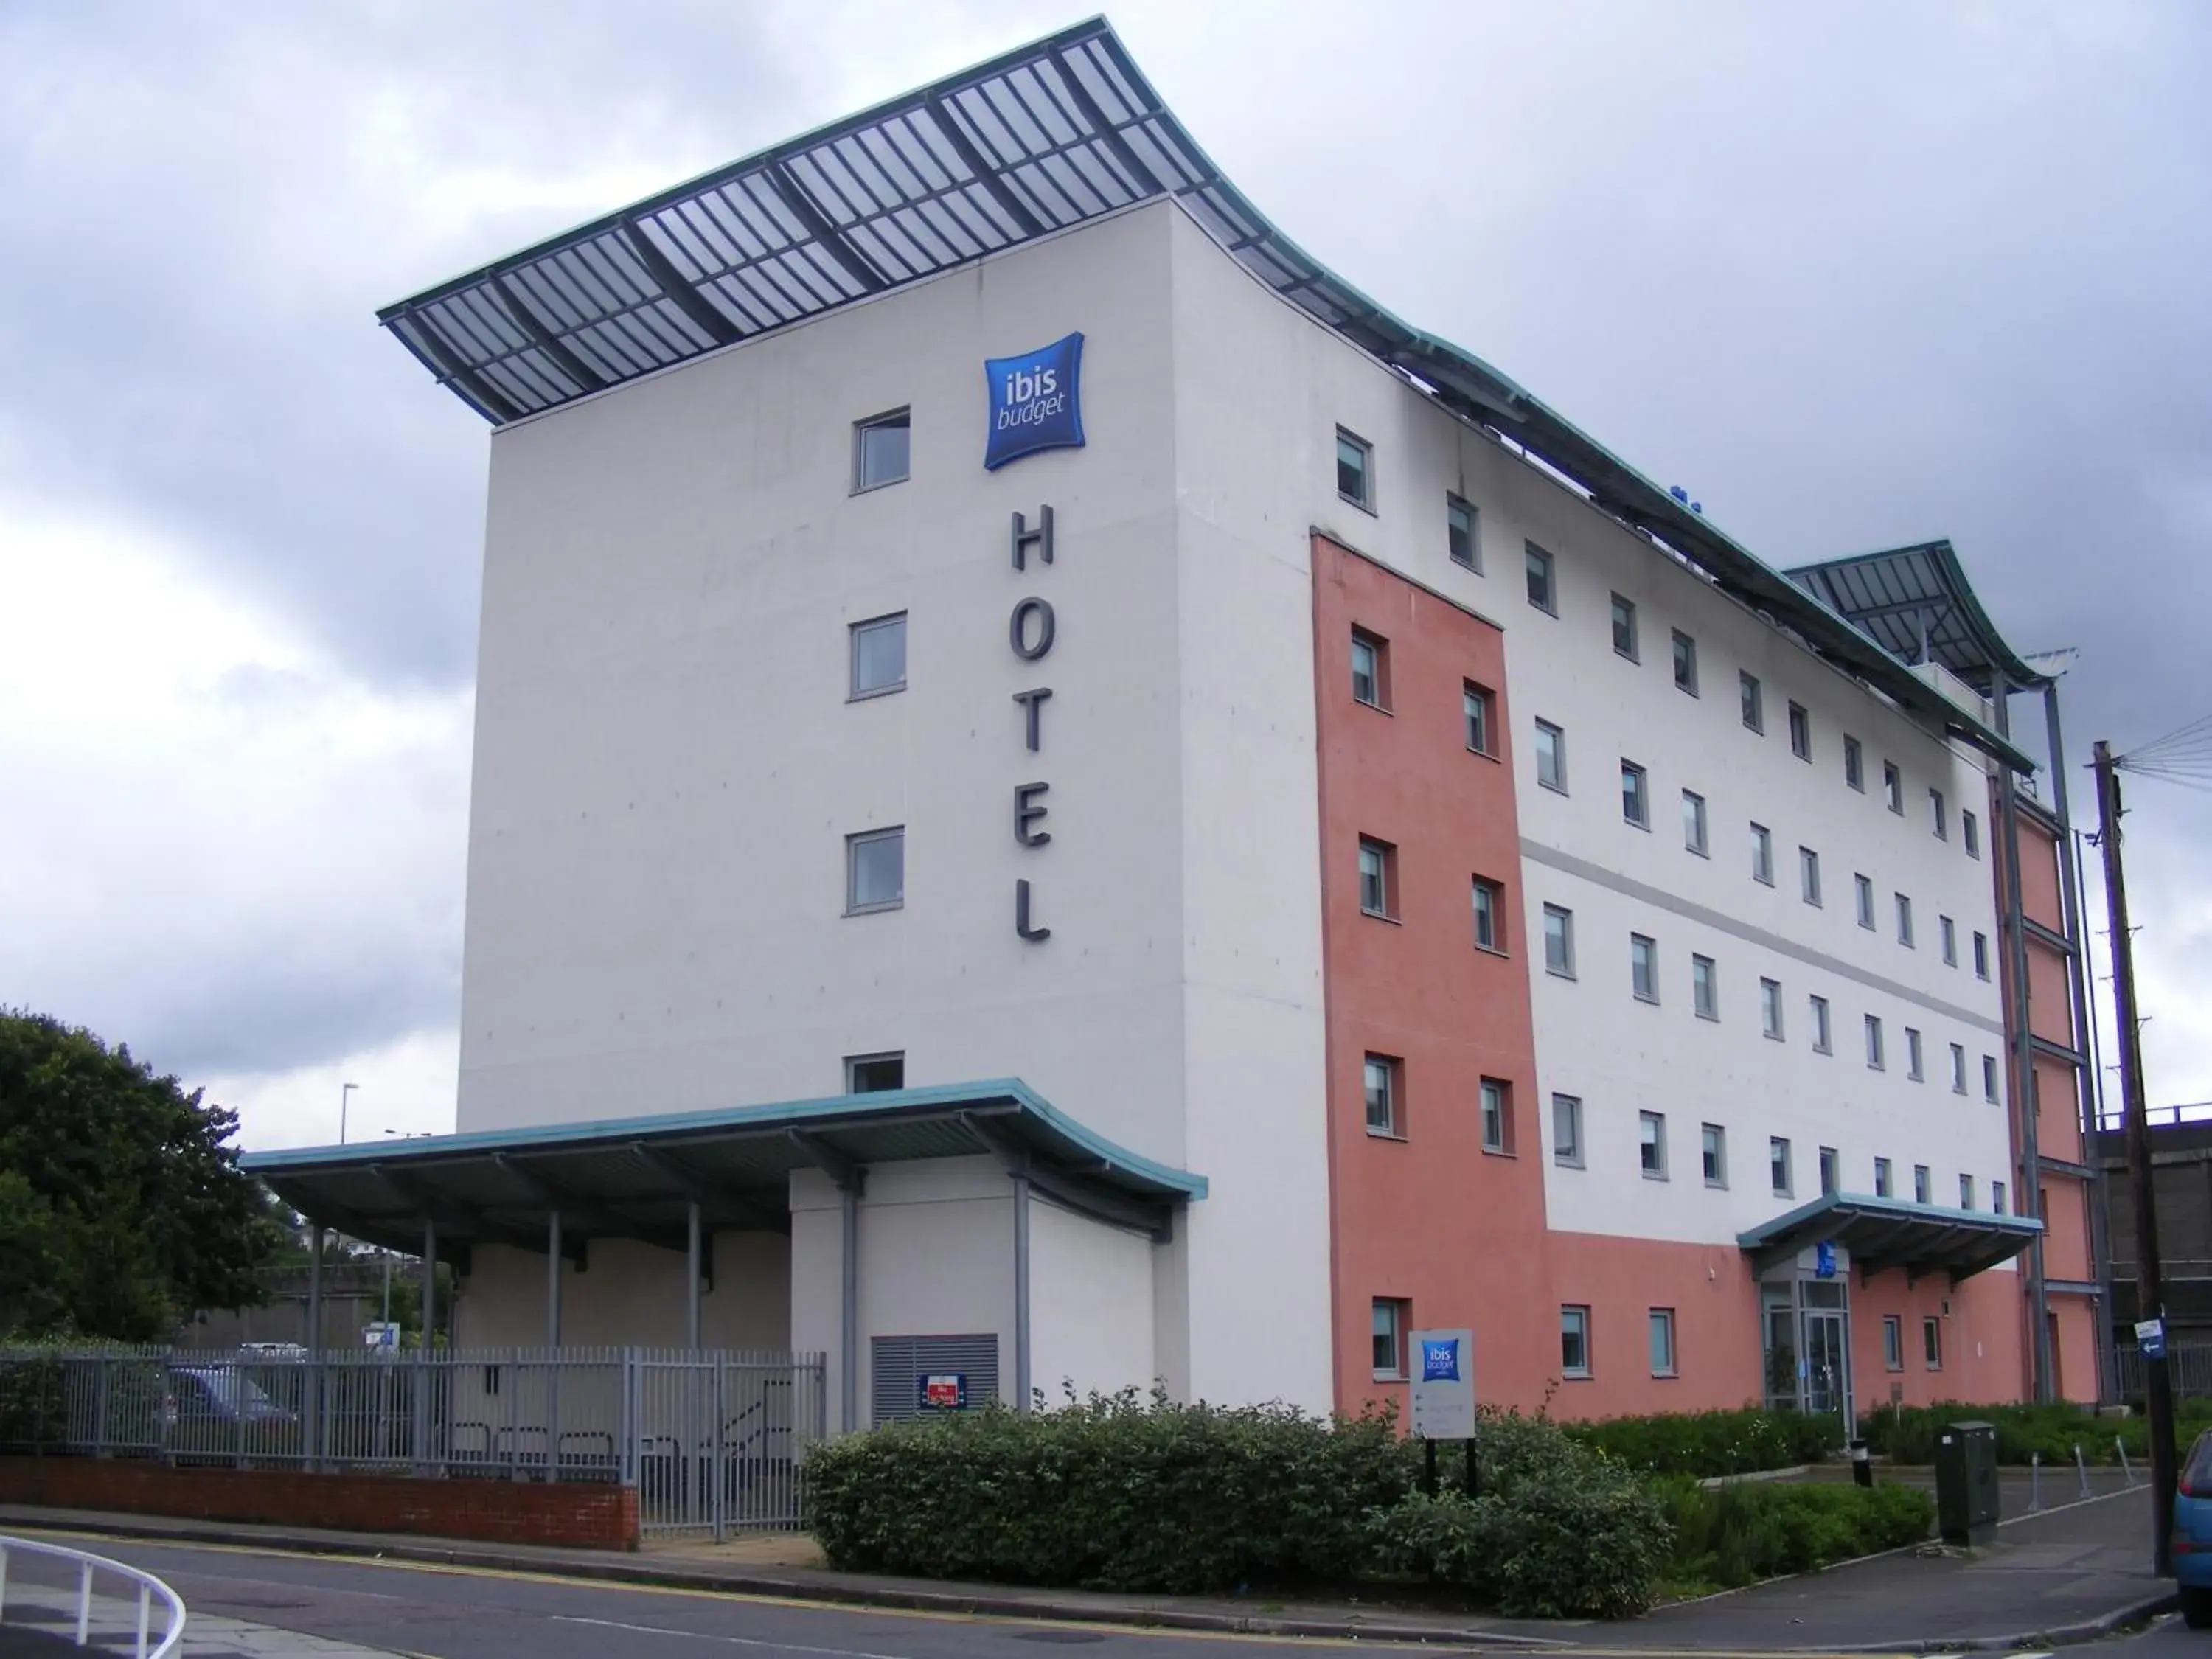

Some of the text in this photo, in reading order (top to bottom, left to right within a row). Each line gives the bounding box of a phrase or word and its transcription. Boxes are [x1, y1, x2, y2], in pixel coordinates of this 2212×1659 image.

[1006, 366, 1057, 405] ibis
[998, 392, 1065, 430] budget
[1009, 504, 1055, 940] HOTEL
[1430, 1347, 1450, 1360] ibis
